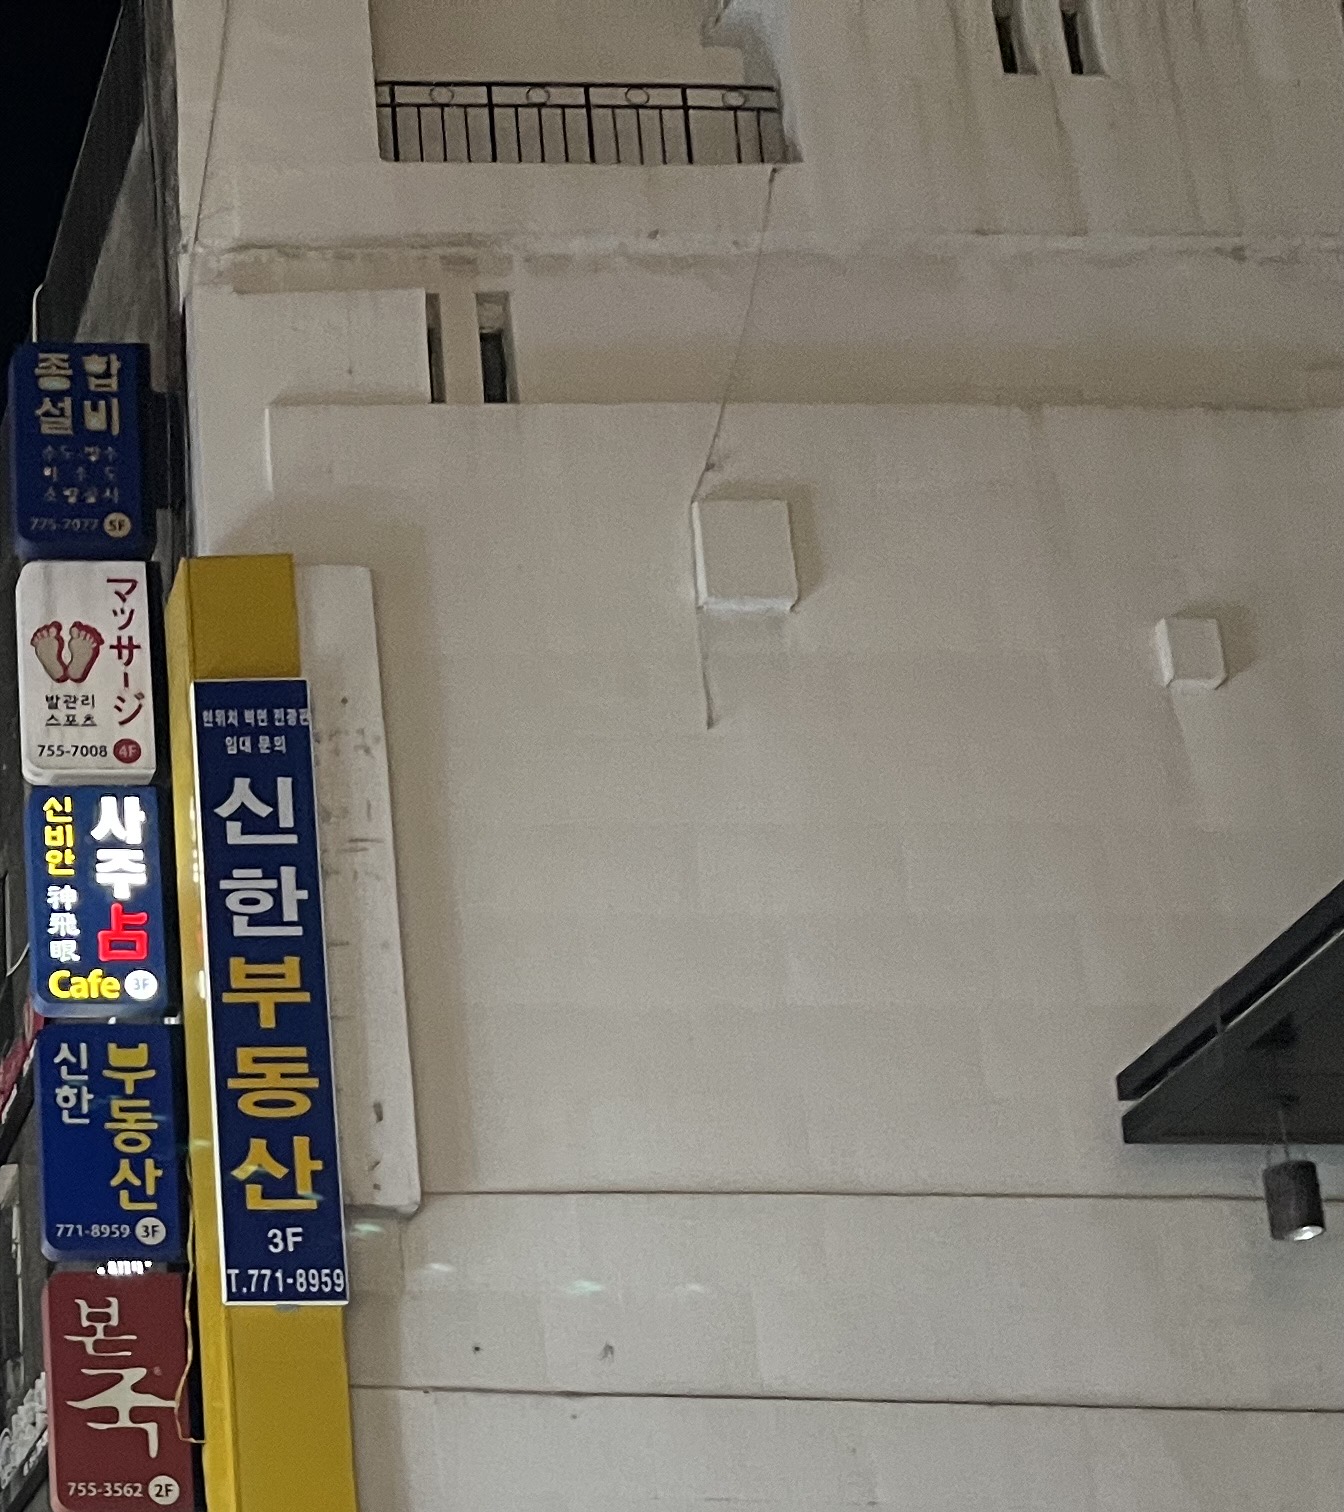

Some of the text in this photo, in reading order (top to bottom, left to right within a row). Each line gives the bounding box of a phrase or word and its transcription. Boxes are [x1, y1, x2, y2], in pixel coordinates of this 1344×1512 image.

[34, 397, 120, 437] 설비
[107, 578, 146, 726] マッサージ
[45, 694, 96, 710] 발관리
[44, 713, 98, 727] 스포츠
[37, 745, 108, 758] 755-7008
[225, 735, 287, 754] 임대 문의
[42, 796, 76, 876] 신비안
[48, 968, 121, 999] Cafe
[53, 1042, 94, 1124] 신한
[102, 1042, 164, 1211] 부동산
[55, 1223, 131, 1239] 771-8959
[140, 1224, 160, 1238] 3F
[267, 1226, 304, 1254] 3F
[226, 1268, 346, 1294] T.771-8959
[63, 1296, 179, 1460] 본죽
[67, 1481, 144, 1497] 755-3562
[153, 1483, 174, 1497] 2F
